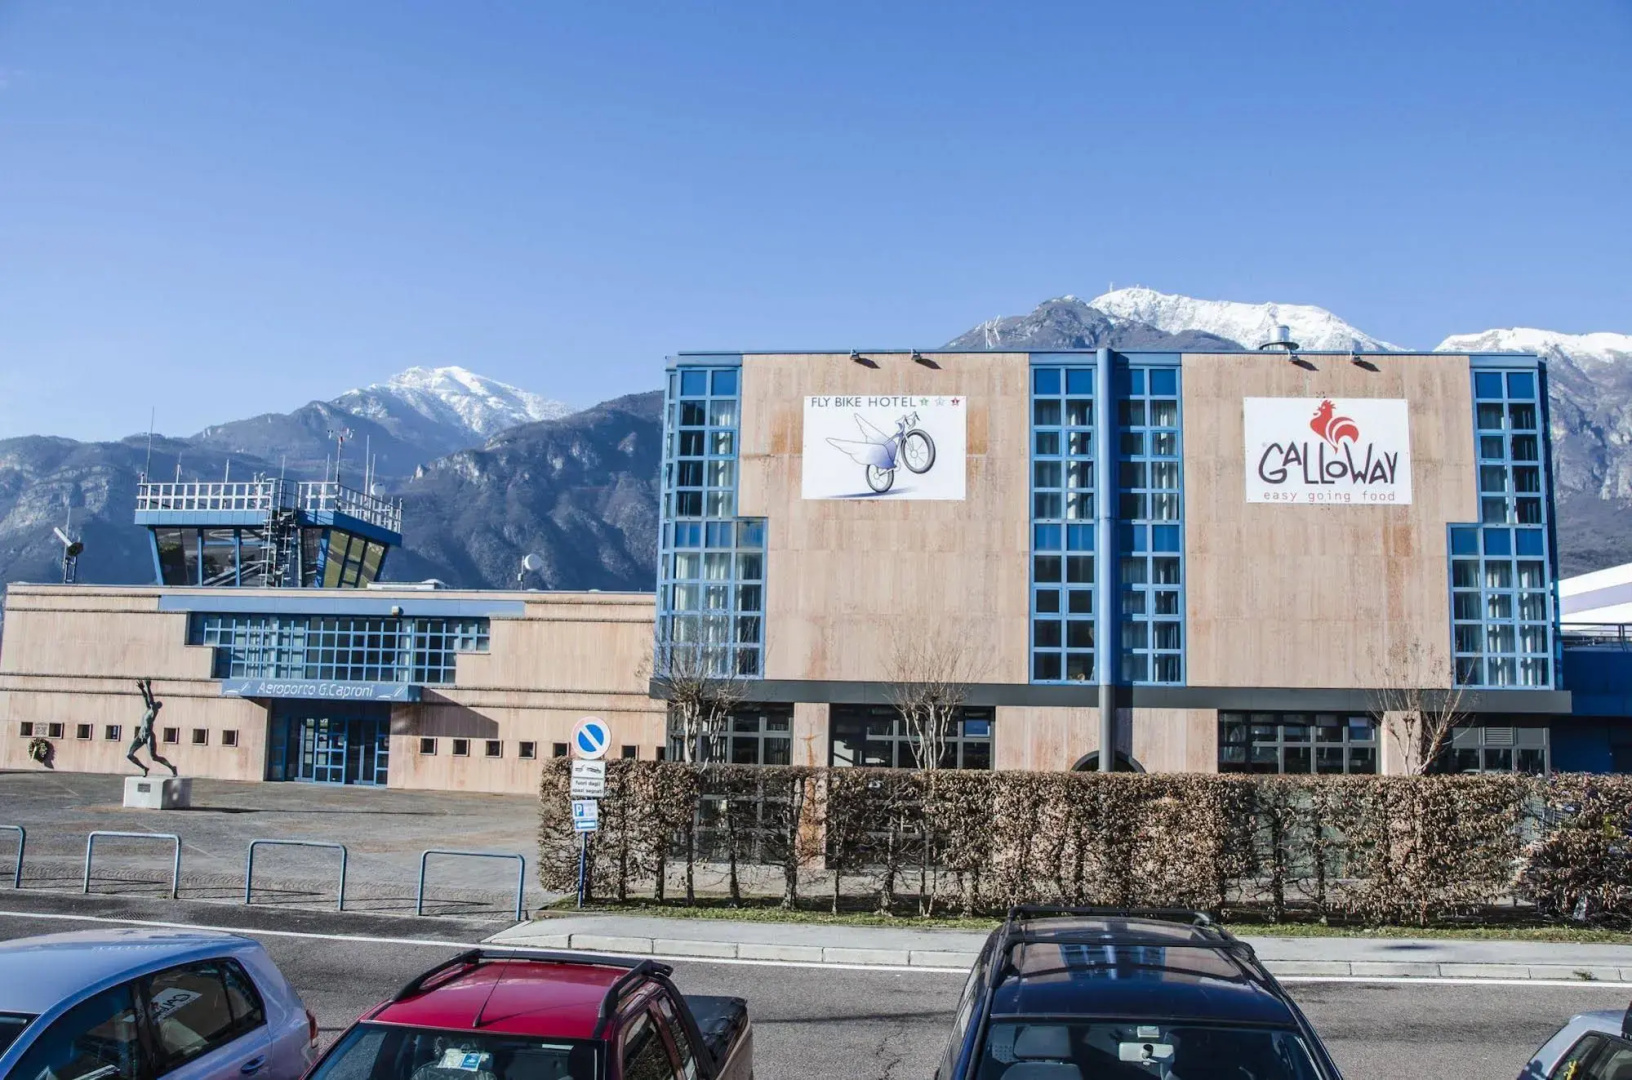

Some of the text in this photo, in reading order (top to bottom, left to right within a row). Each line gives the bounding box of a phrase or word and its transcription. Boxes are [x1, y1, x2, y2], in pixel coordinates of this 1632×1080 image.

[811, 397, 917, 408] FLY BIKE HOTEL
[1263, 490, 1396, 503] easy going food
[257, 682, 374, 698] Aeroporto G.Caproni
